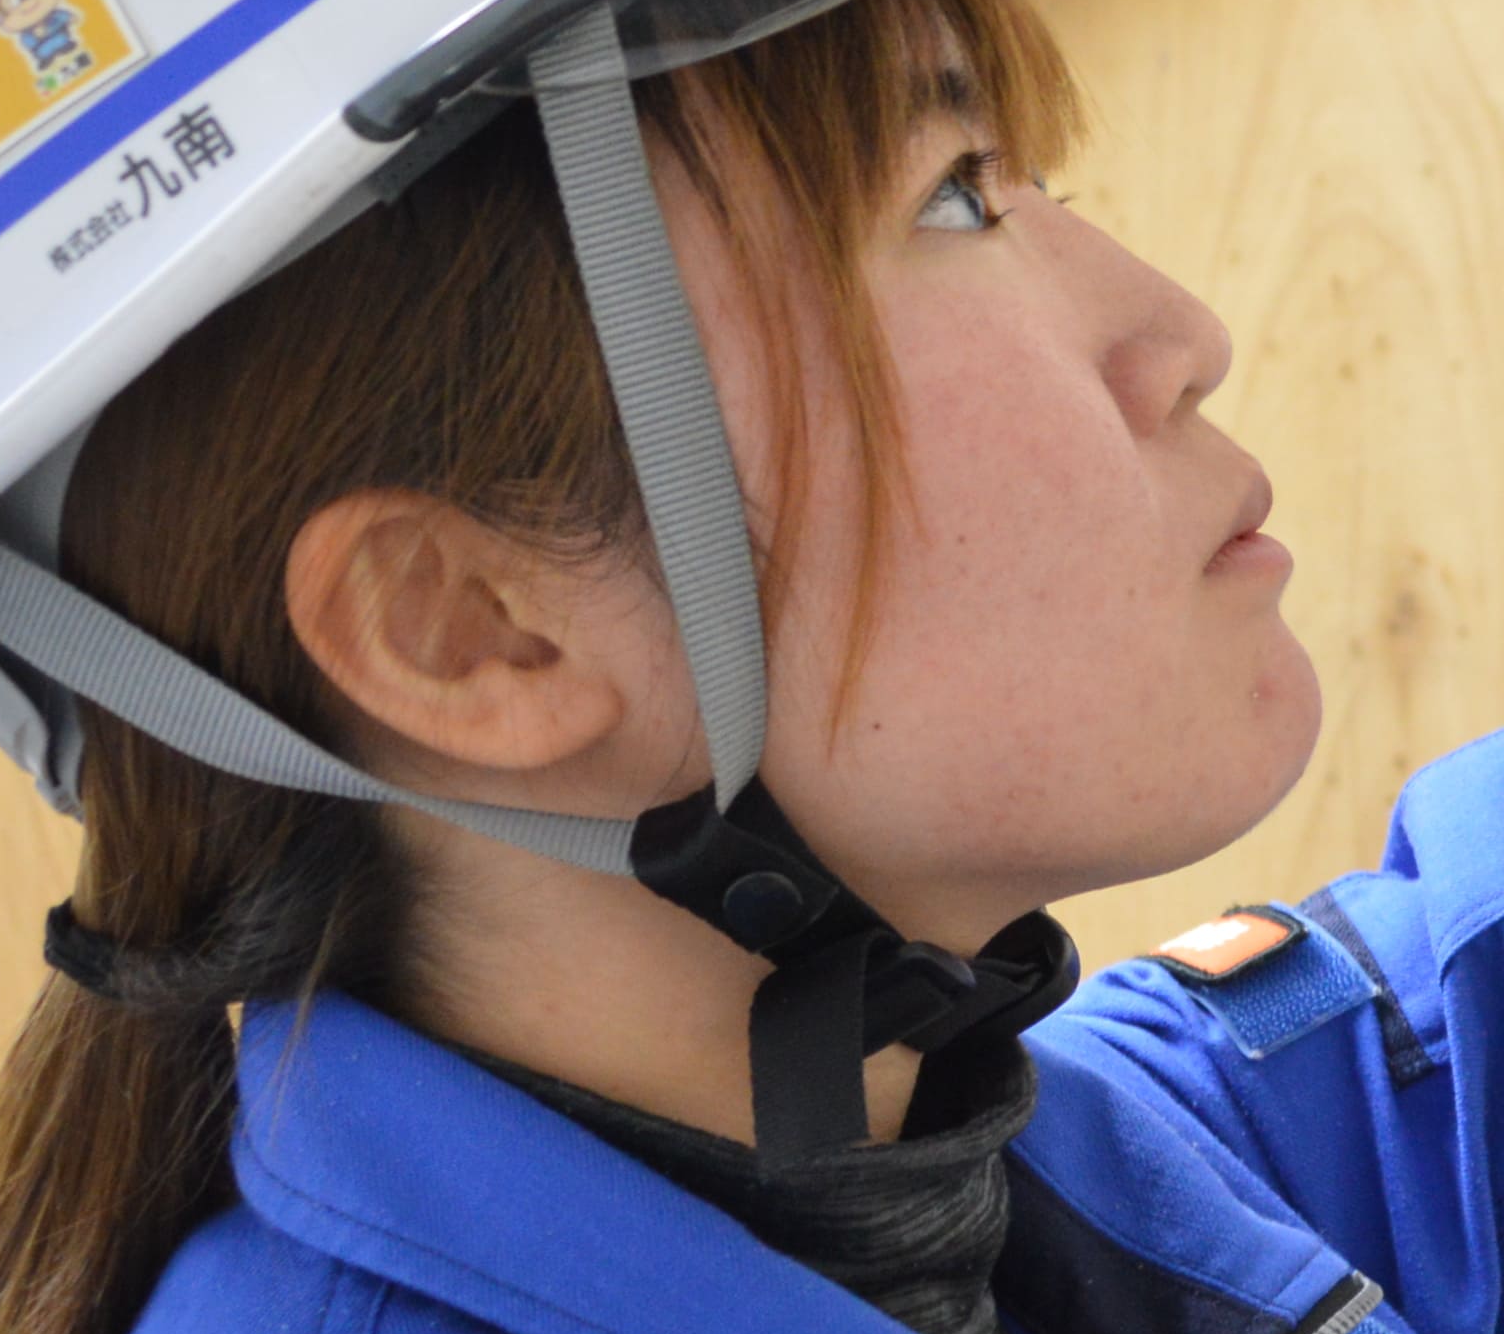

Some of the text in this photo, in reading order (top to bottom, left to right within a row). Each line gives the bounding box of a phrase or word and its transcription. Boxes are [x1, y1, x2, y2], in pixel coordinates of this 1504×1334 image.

[47, 104, 236, 274] 株式会社九南
